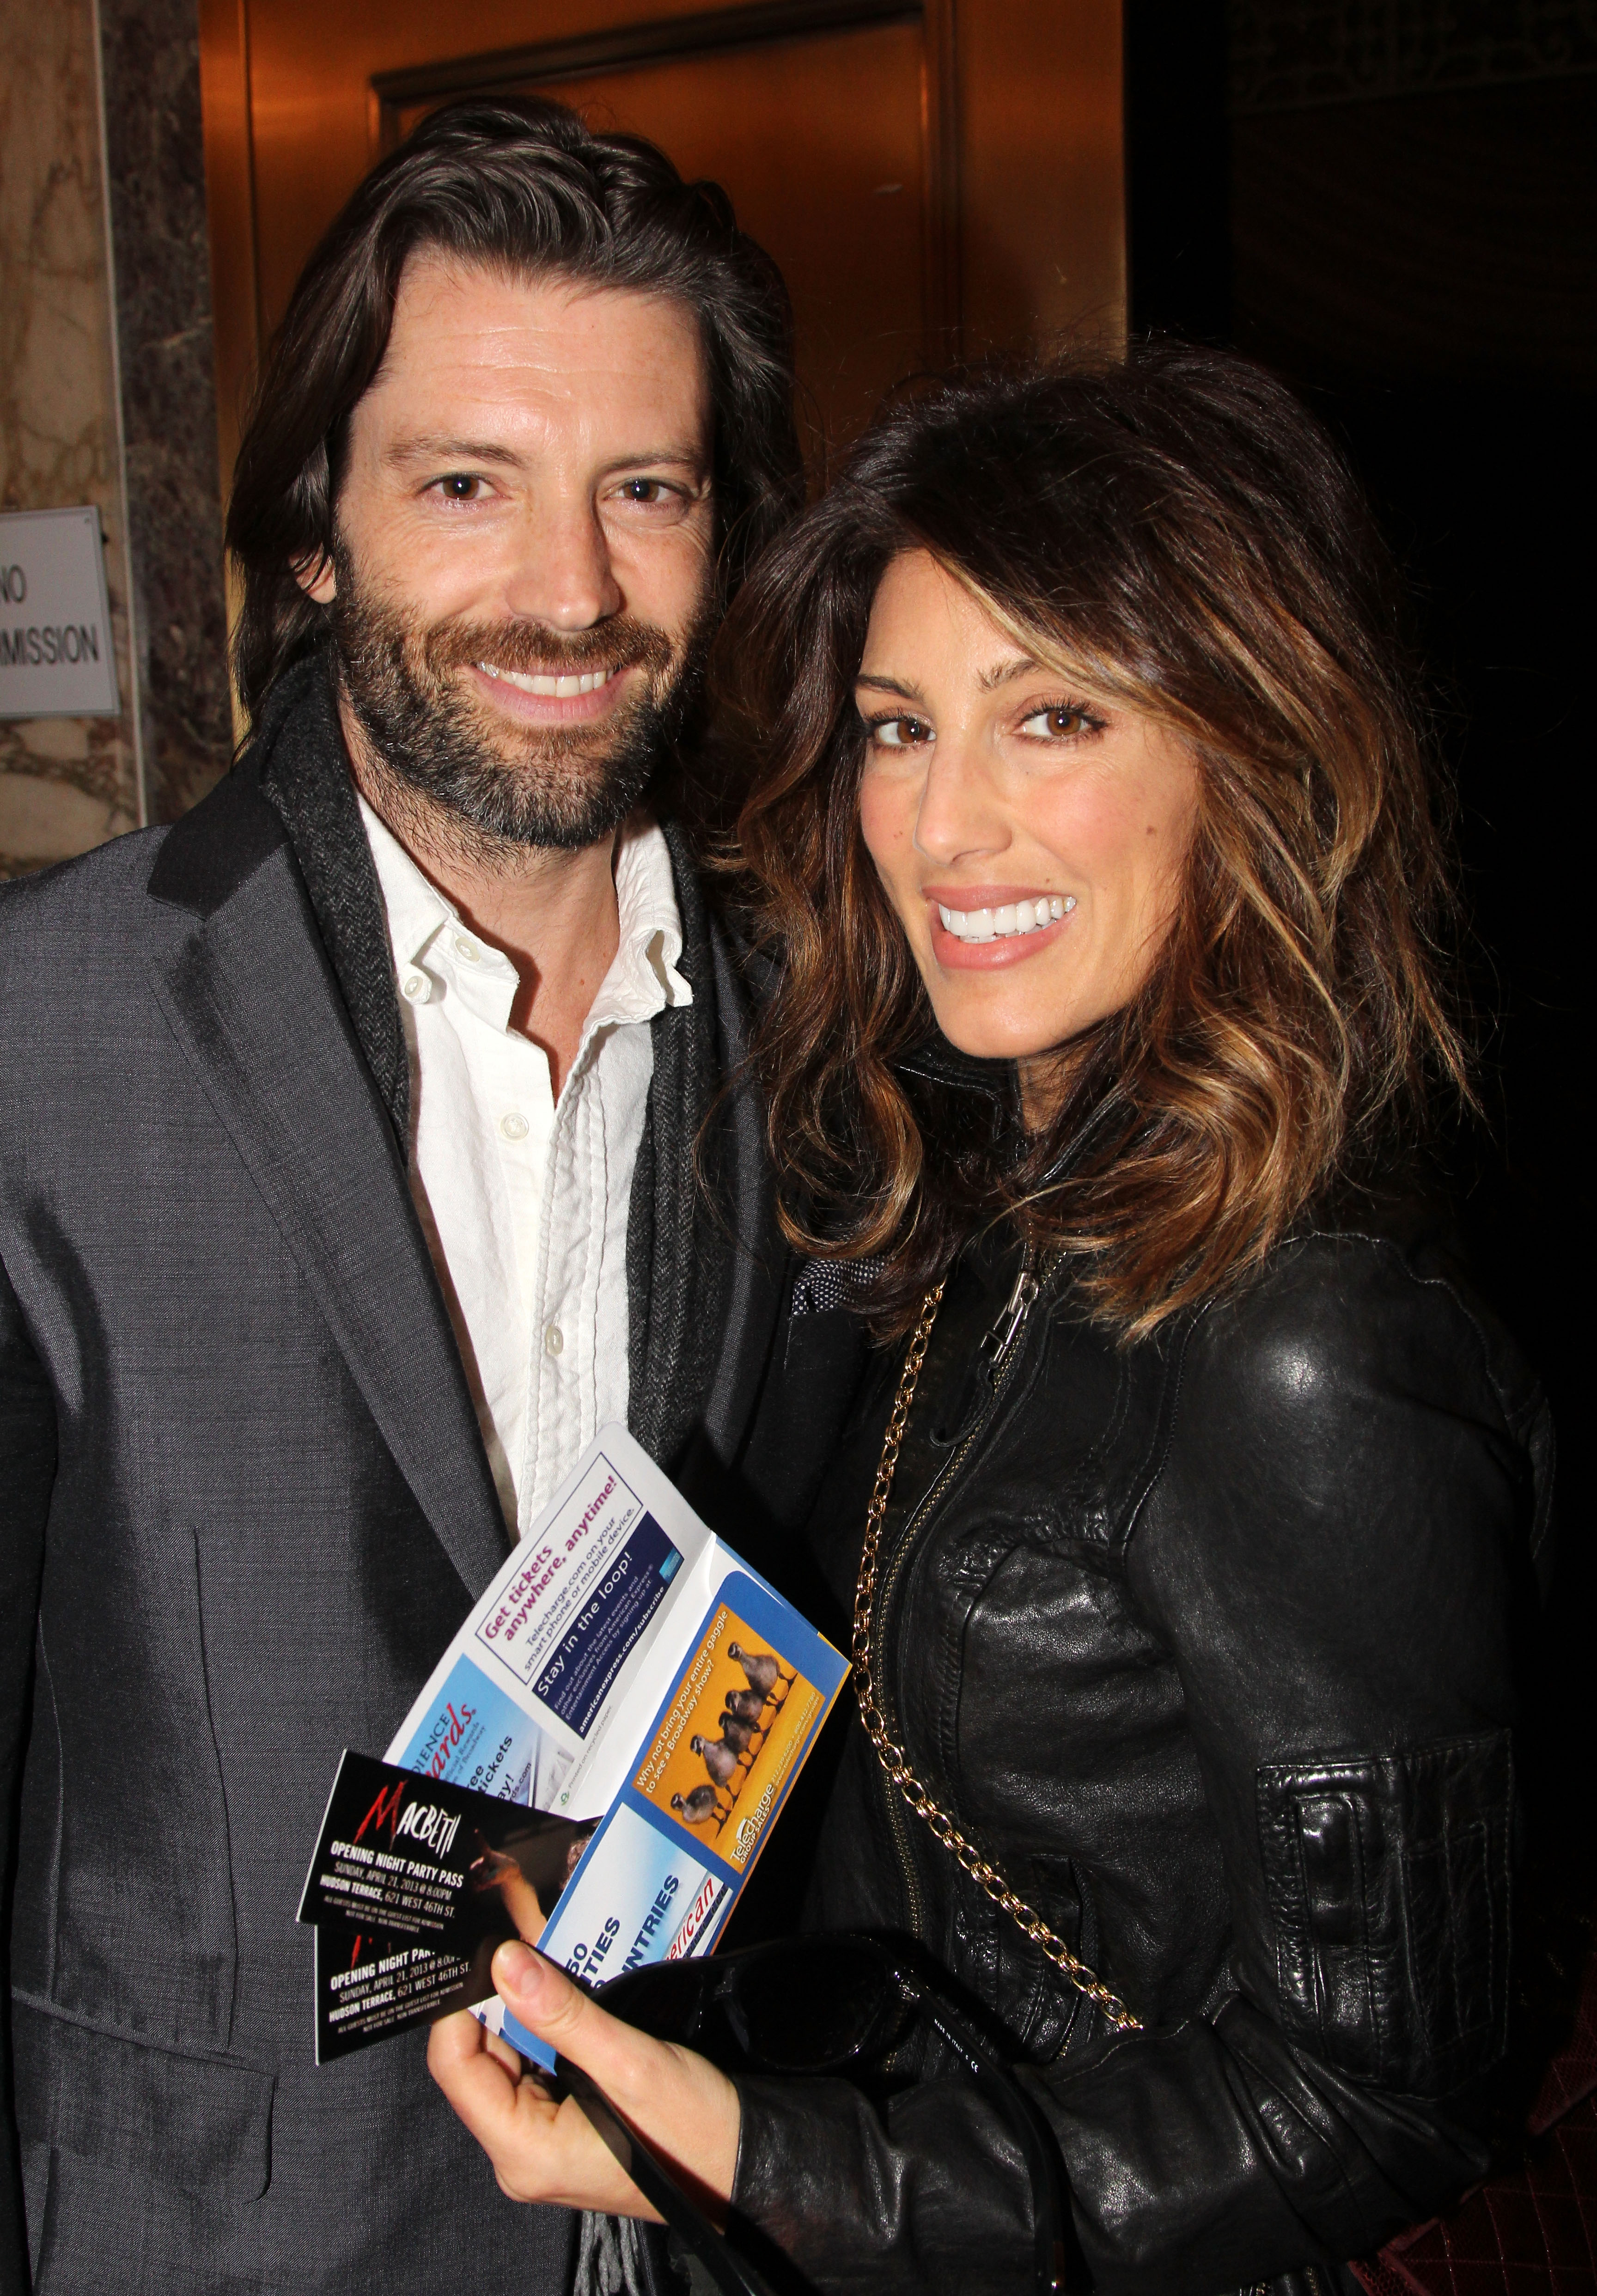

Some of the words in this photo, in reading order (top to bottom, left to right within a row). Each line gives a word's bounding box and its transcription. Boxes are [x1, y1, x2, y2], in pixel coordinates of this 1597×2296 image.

[0, 624, 99, 666] MISSION
[485, 1606, 510, 1639] Get
[509, 1546, 552, 1604] tickets
[504, 1557, 566, 1641] anywhere,
[565, 1475, 616, 1551] anytime!
[524, 1637, 547, 1670] smart
[546, 1600, 571, 1638] phone
[571, 1585, 580, 1598] or
[580, 1543, 608, 1584] mobile
[608, 1509, 634, 1545] device.
[526, 1561, 586, 1645] Telecharge.com
[586, 1545, 597, 1560] on
[597, 1517, 615, 1545] your
[538, 1655, 564, 1696] Stay
[562, 1635, 578, 1653] in
[578, 1602, 599, 1630] the
[598, 1551, 632, 1599] loop!
[554, 1691, 566, 1709] Find
[565, 1676, 574, 1691] out
[574, 1652, 588, 1677] about
[587, 1638, 597, 1651] the
[596, 1617, 611, 1637] latest
[611, 1593, 628, 1616] events
[628, 1576, 638, 1591] and
[561, 1693, 573, 1715] other
[573, 1654, 598, 1691] exclusives
[594, 1634, 608, 1653] from
[608, 1600, 631, 1636] American
[563, 1665, 596, 1720] Entertainment
[596, 1639, 612, 1665] Access
[612, 1628, 619, 1638] by
[619, 1597, 639, 1628] signing
[638, 1588, 646, 1600] up
[579, 1587, 663, 1732] americanexpress.com/subscribe
[637, 1761, 654, 1786] Why
[652, 1740, 664, 1760] not
[660, 1709, 681, 1739] bring
[677, 1681, 692, 1710] your
[690, 1649, 709, 1681] entire
[707, 1611, 727, 1649] gaggle
[646, 1781, 655, 1793] to
[653, 1759, 666, 1780] see
[667, 1695, 697, 1750] Broadway
[695, 1659, 713, 1695] show?
[330, 1840, 374, 1864] OPENING
[375, 1852, 406, 1872] NIGHT
[406, 1861, 438, 1880] PARTY
[439, 1869, 463, 1887] PASS
[730, 1783, 774, 1862] Telecharge
[738, 1832, 756, 1863] GROUP
[755, 1805, 770, 1832] SALES
[320, 1875, 351, 1891] HUDSON
[351, 1881, 383, 1901] TERRACE,
[384, 1891, 400, 1904] 621
[402, 1895, 422, 1909] WEST
[423, 1901, 443, 1914] 46TH
[444, 1905, 456, 1918] ST.
[334, 1861, 364, 1880] SUNDAY,
[366, 1869, 386, 1884] APRIL
[400, 1878, 419, 1892] 2013
[419, 1883, 426, 1893] @
[426, 1885, 452, 1900] 8:00PM
[666, 1878, 713, 1960] erican
[329, 2002, 360, 2022] HUDSON
[361, 1990, 396, 2010] TERRACE,
[397, 1983, 411, 1997] 621
[414, 1974, 435, 1991] WEST
[438, 1966, 457, 1981] 46TH
[460, 1962, 470, 1974] ST.
[330, 1963, 375, 1990] OPENING
[378, 1951, 408, 1973] NIGHT
[340, 1983, 372, 2003] SUNDAY,
[373, 1975, 393, 1991] APRIL
[410, 1962, 427, 1978] 2013
[429, 1960, 435, 1970] @
[934, 2018, 945, 2033] MADE
[952, 2039, 963, 2053] ITALY
